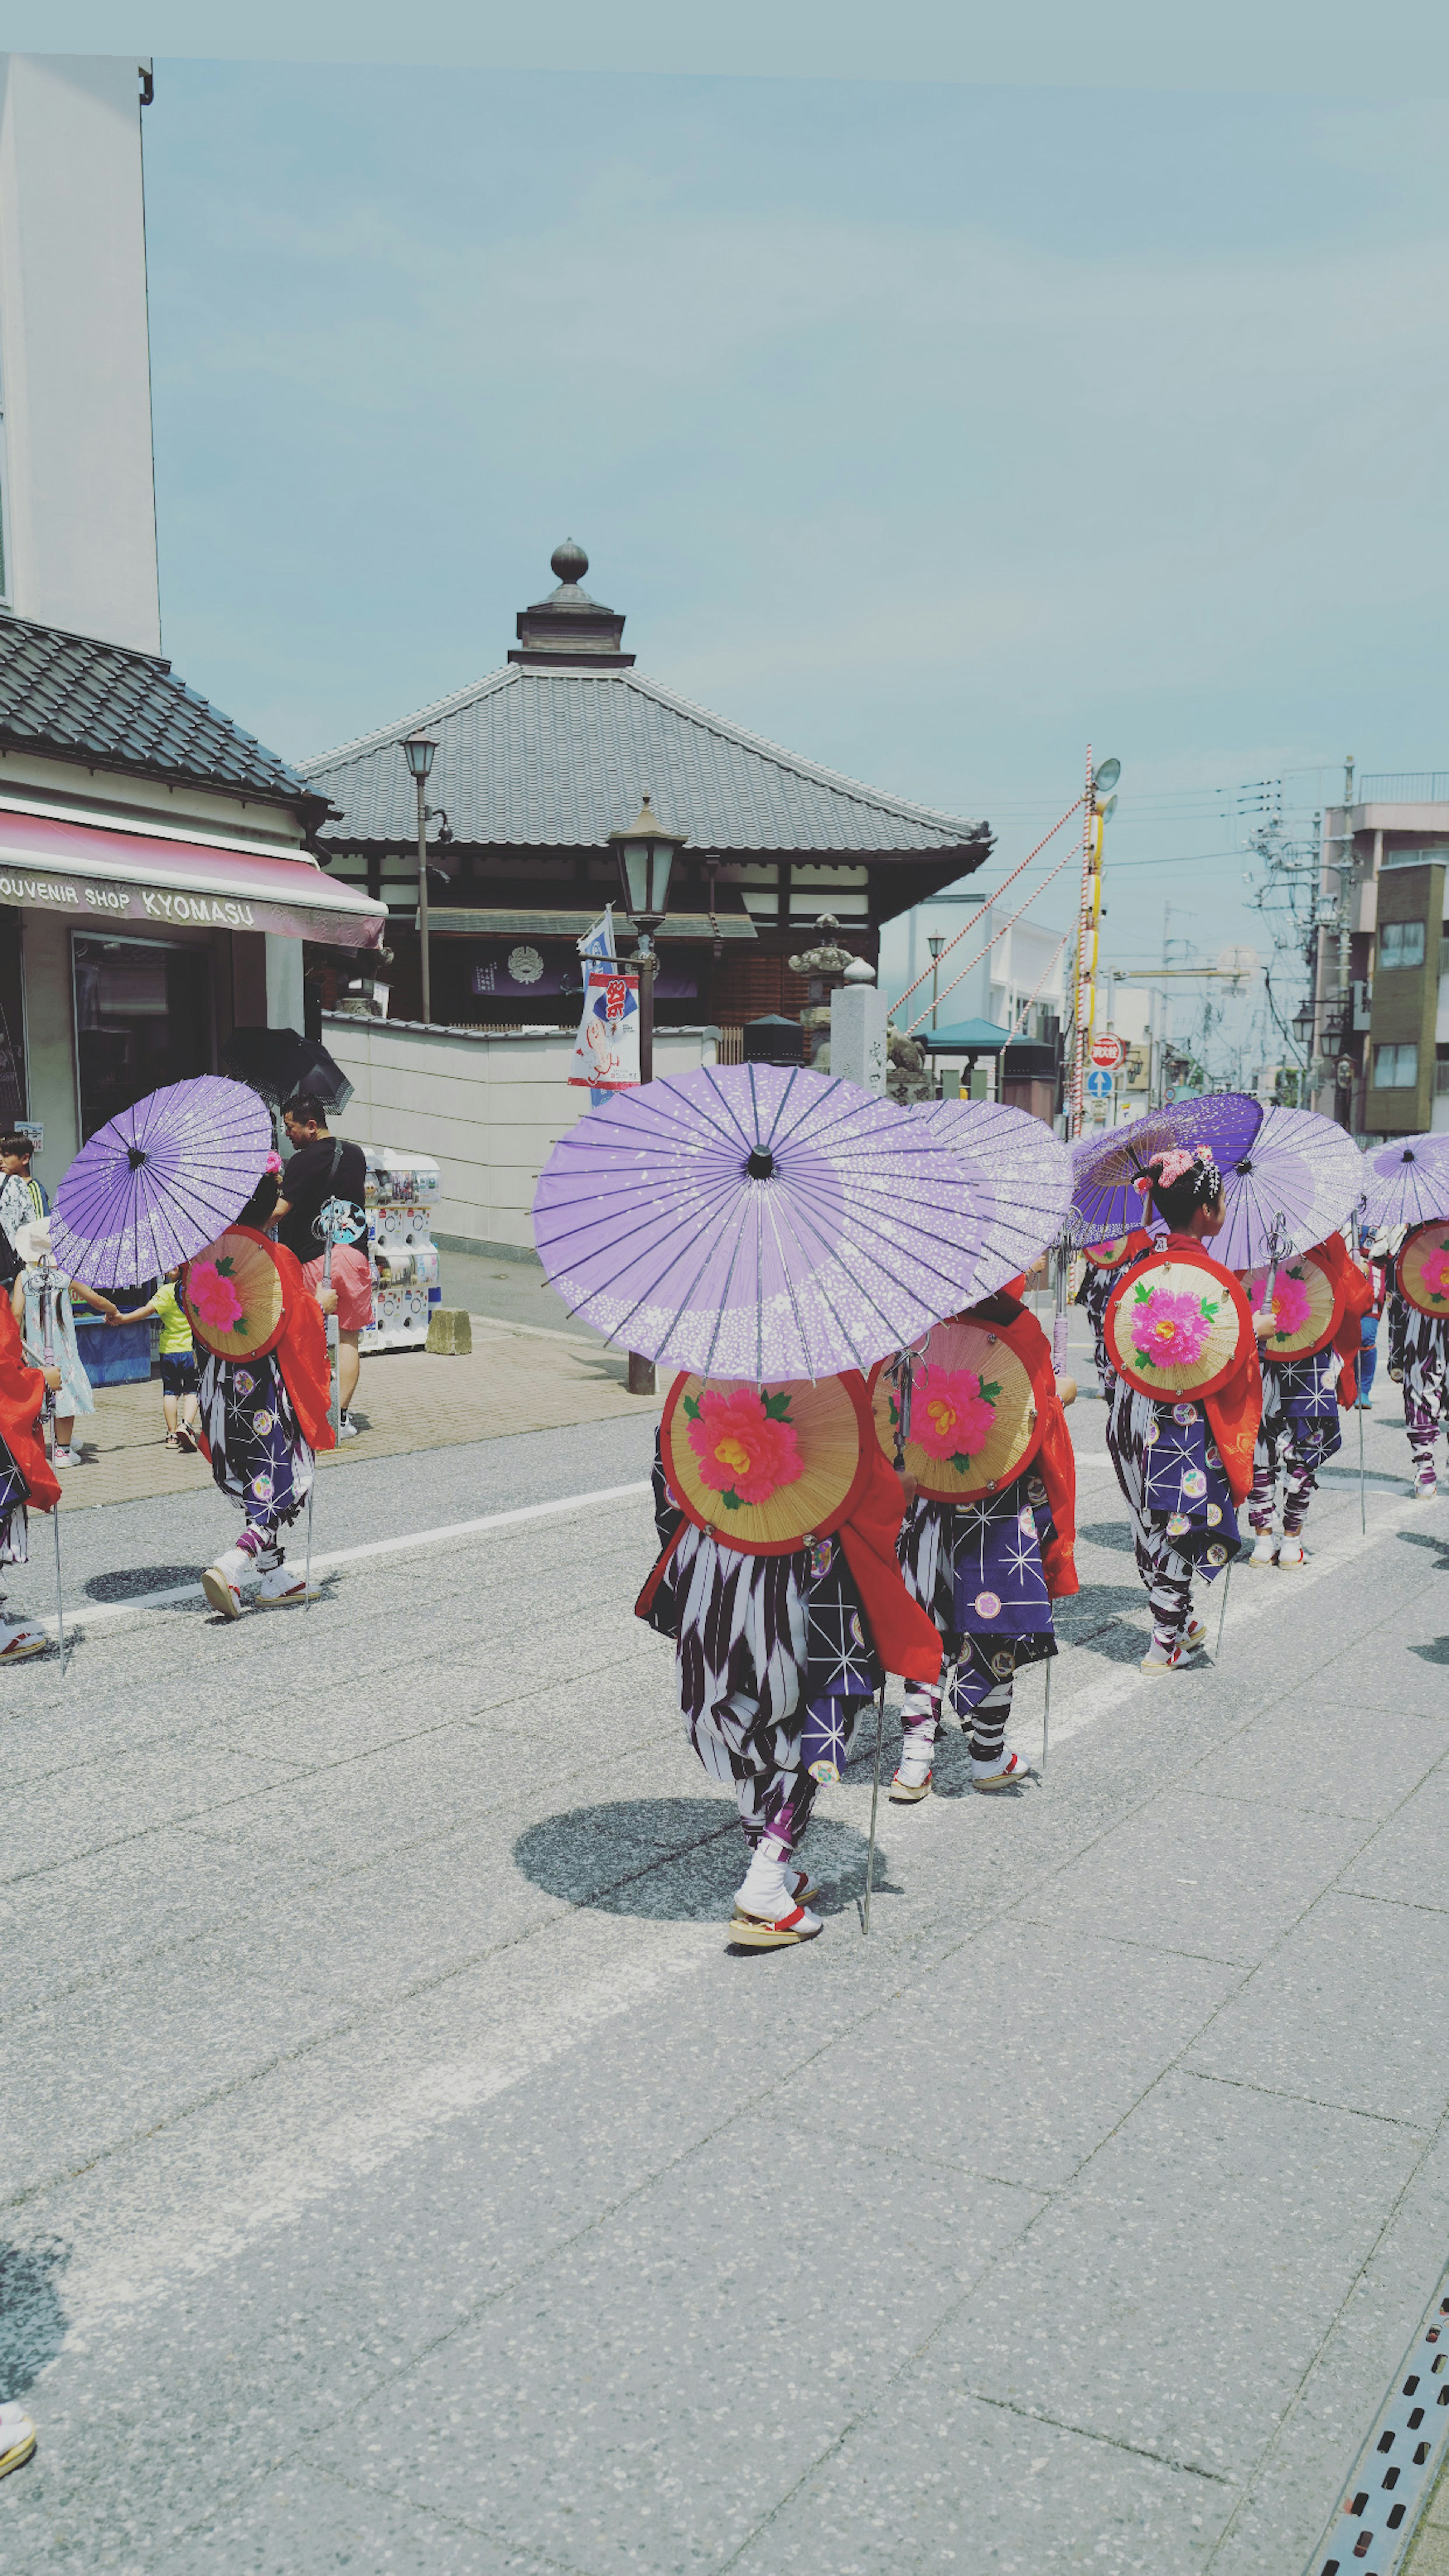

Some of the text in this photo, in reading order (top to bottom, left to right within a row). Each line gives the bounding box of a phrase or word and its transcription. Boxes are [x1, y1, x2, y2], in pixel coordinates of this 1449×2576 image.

[0, 878, 254, 926] OUVENIR SHOP KYOMASU
[606, 980, 625, 1019] 祭
